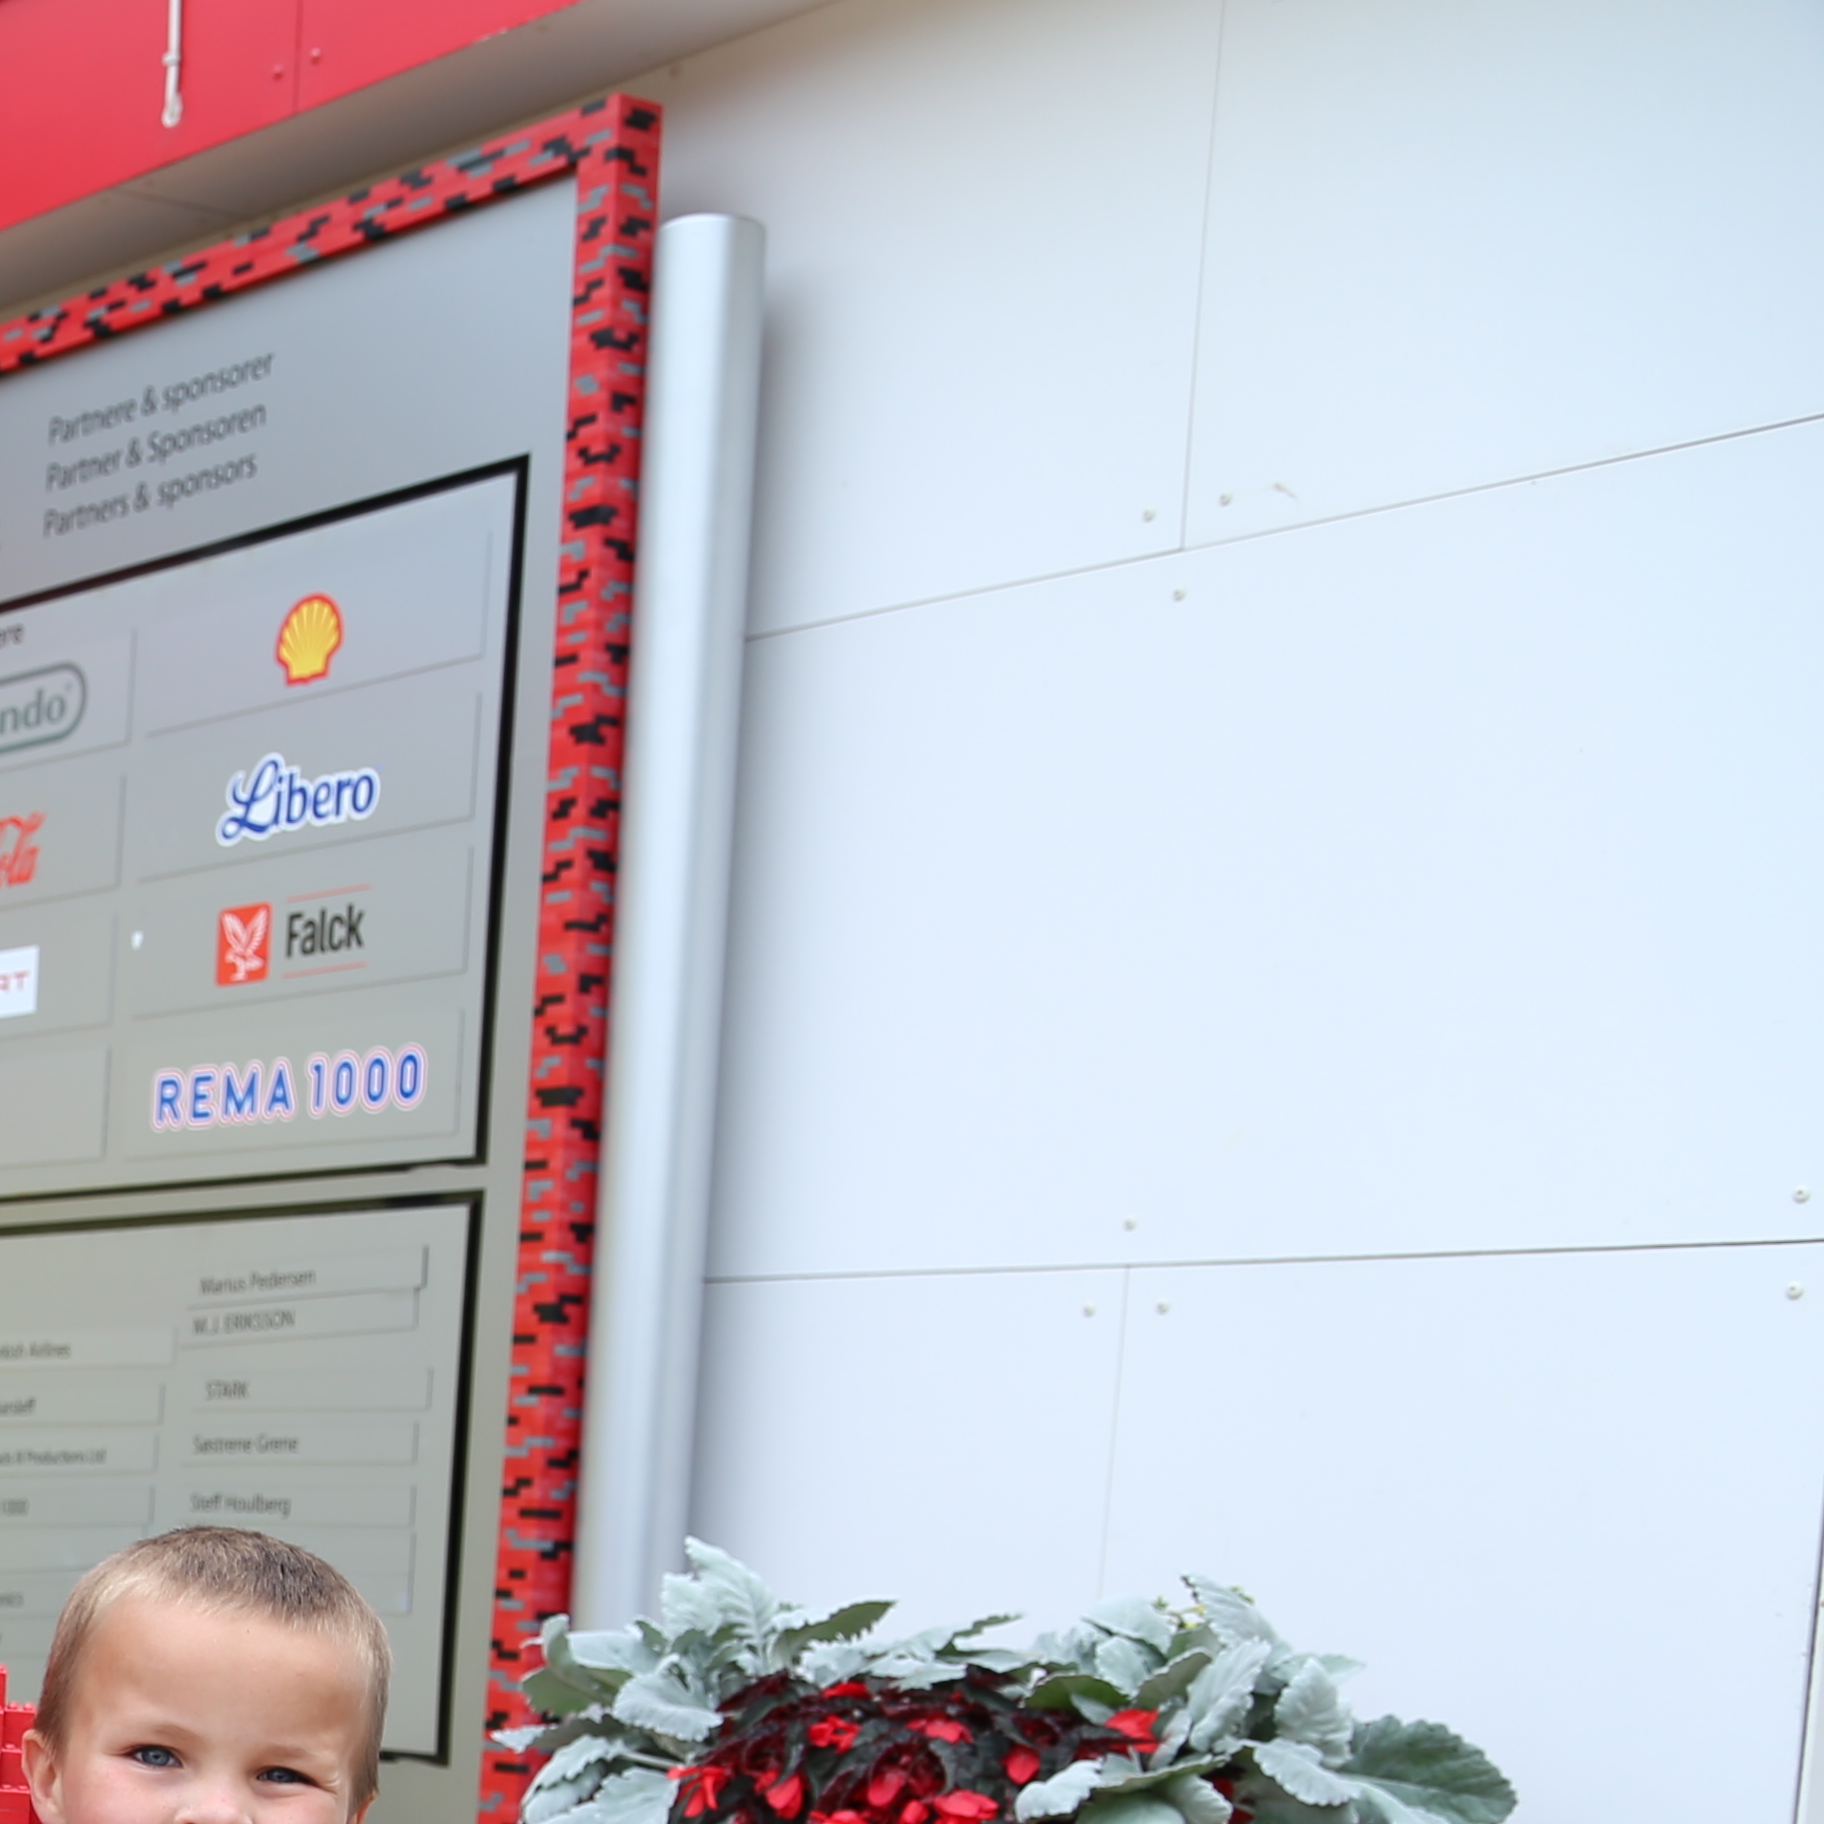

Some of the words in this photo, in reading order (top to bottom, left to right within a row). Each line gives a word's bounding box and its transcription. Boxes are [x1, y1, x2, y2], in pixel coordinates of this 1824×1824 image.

[48, 394, 137, 446] Partnere
[140, 386, 158, 417] &
[162, 352, 274, 411] sponsorer
[47, 448, 121, 491] Partner
[125, 437, 142, 469] &
[147, 404, 267, 463] Sponsoren
[45, 495, 130, 537] Partners
[134, 482, 149, 512] &
[157, 454, 257, 510] sponsors
[219, 756, 378, 844] Libero
[286, 905, 366, 958] Falck
[155, 1060, 295, 1128] REMA
[310, 1050, 423, 1116] 1000
[251, 1270, 315, 1290] Pedersen
